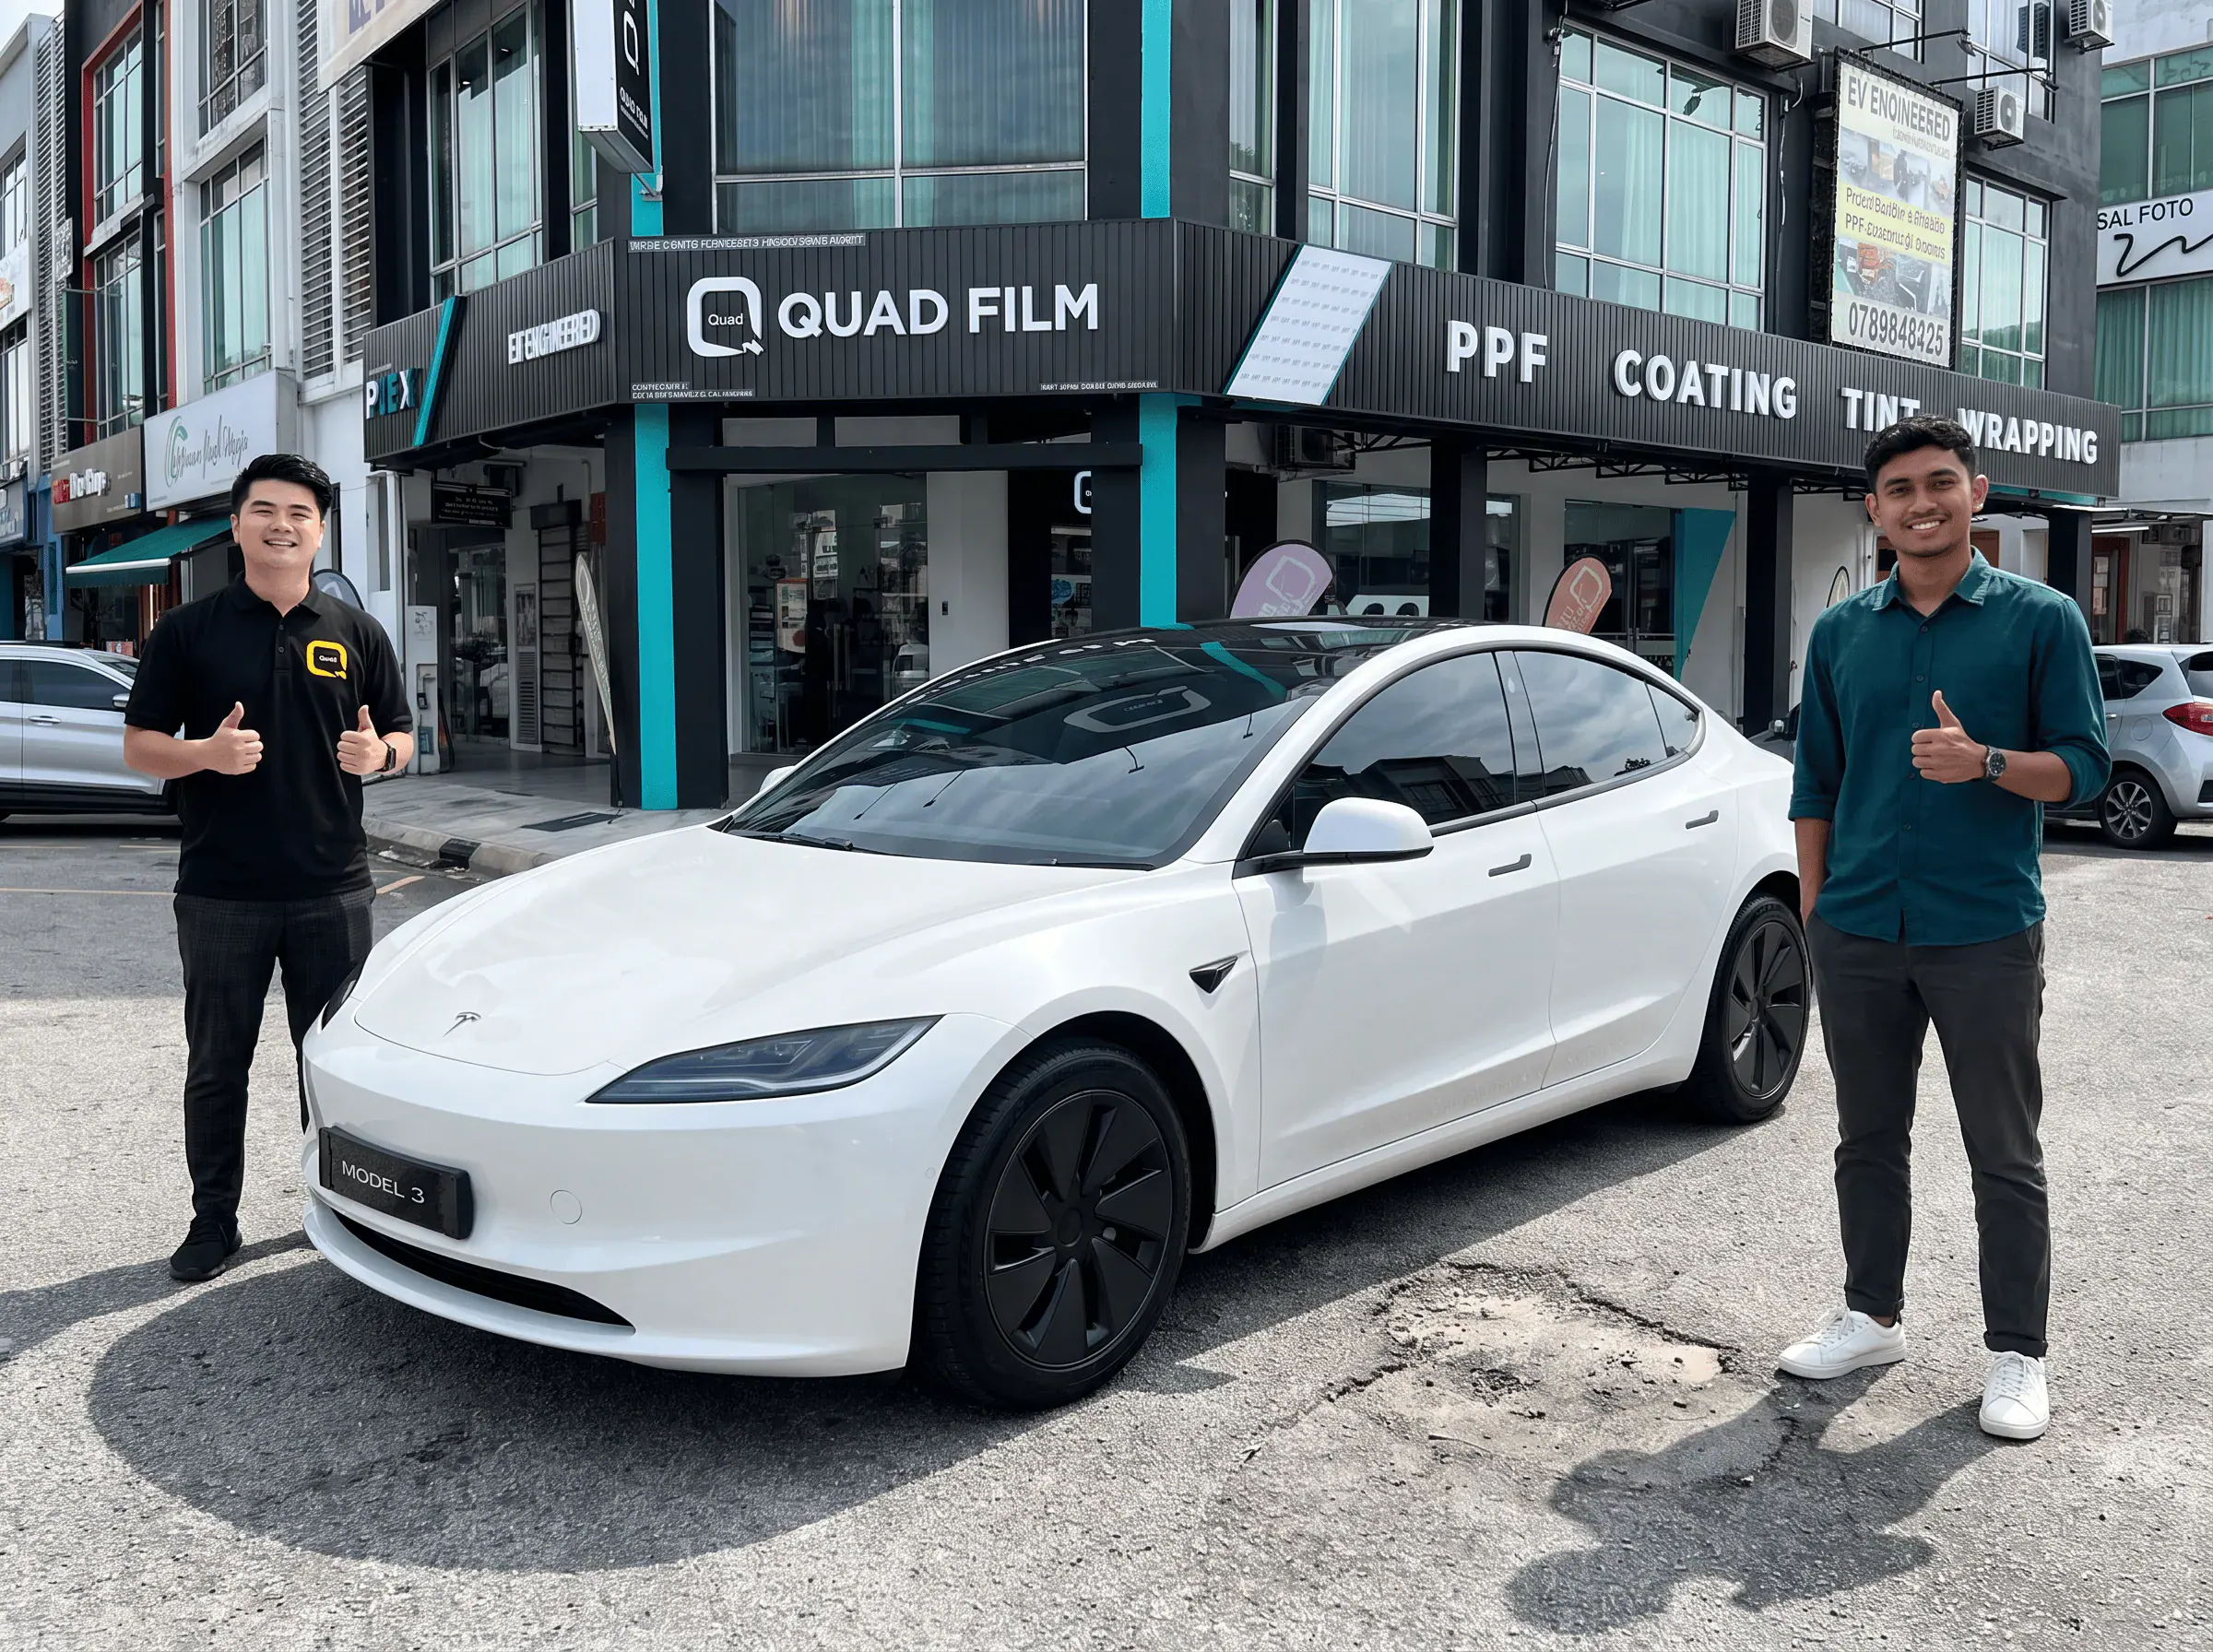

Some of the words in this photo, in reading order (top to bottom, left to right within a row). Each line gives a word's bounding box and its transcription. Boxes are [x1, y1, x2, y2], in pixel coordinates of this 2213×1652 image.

[1848, 75, 1868, 109] EV
[2097, 208, 2134, 230] SAL
[2139, 197, 2194, 224] FOTO
[707, 313, 744, 326] Quad
[777, 289, 949, 339] QUAD
[968, 283, 1099, 334] FILM
[1447, 319, 1548, 384] PPF
[1614, 349, 1797, 419] COATING
[1958, 407, 2098, 466] WRAPPING
[342, 1161, 405, 1198] MODEL
[411, 1186, 425, 1204] 3
